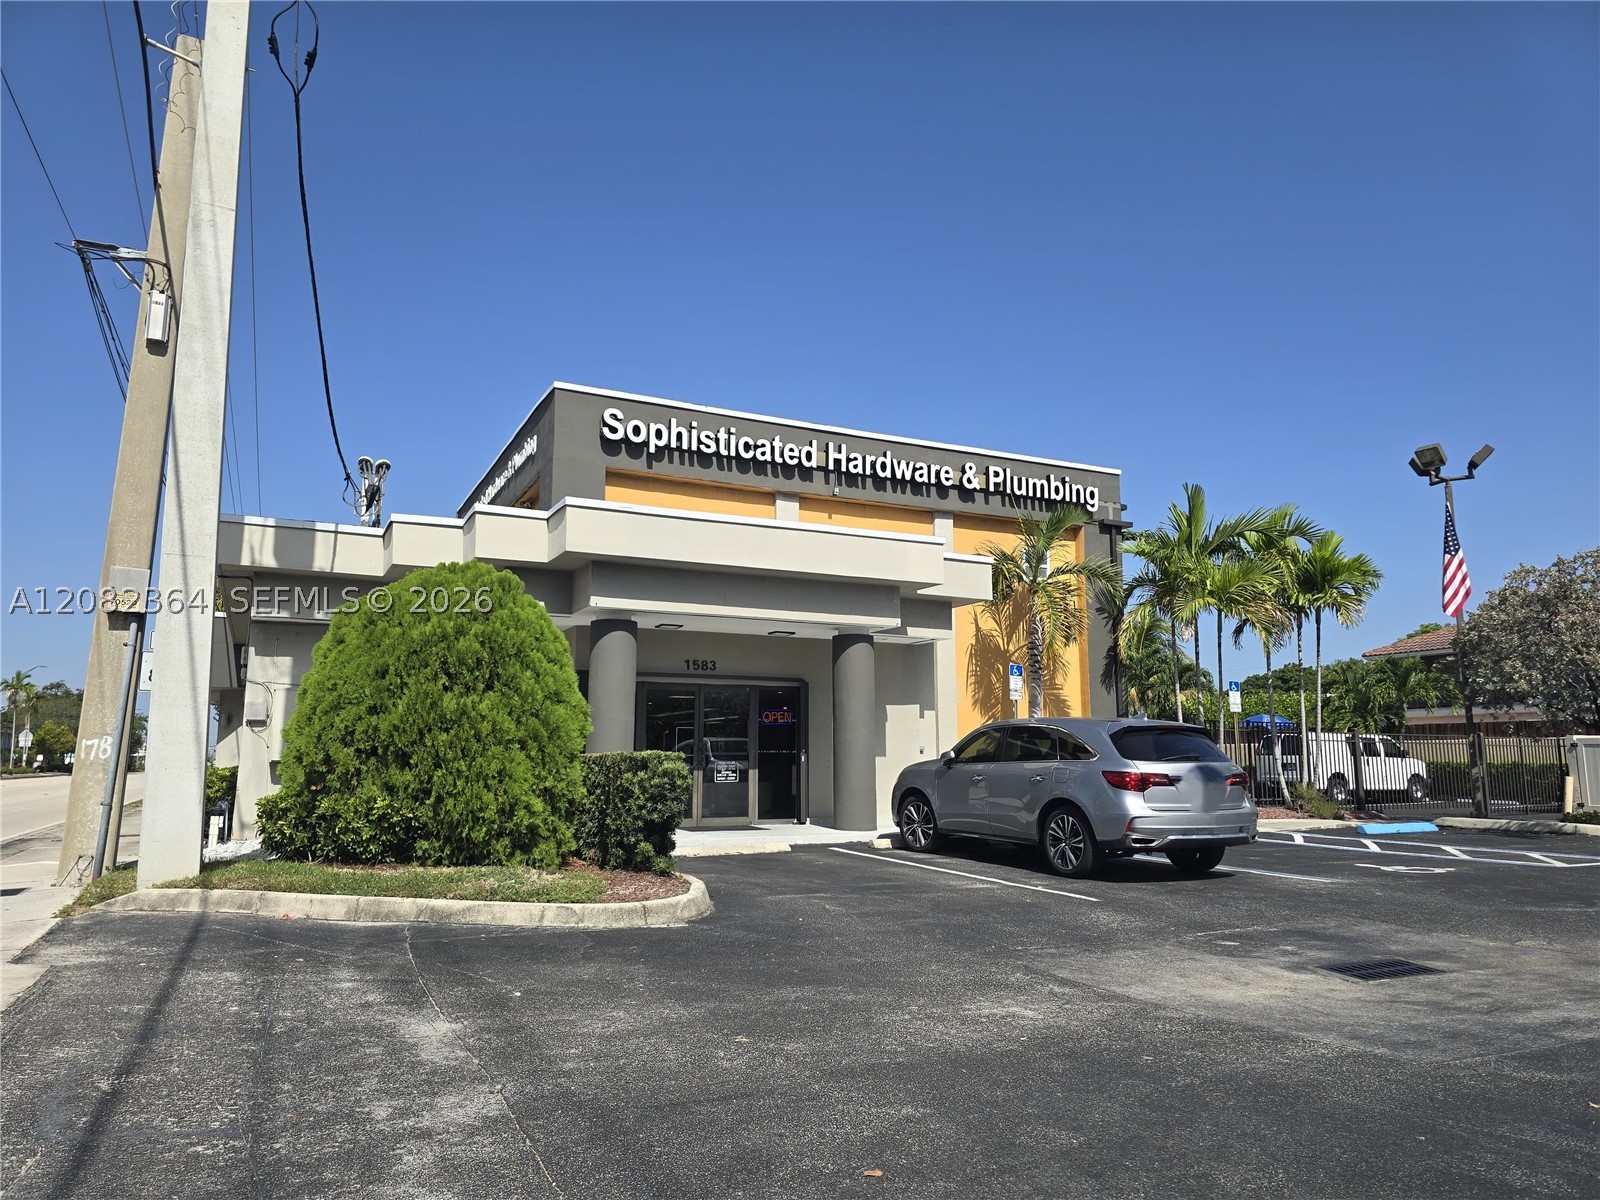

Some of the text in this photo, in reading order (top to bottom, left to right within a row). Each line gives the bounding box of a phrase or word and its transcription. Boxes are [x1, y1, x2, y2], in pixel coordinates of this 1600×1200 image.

[602, 407, 1099, 512] Sophisticated Hardware & Plumbing
[684, 659, 717, 671] 1583
[763, 711, 792, 723] OPEN
[80, 735, 113, 760] 178
